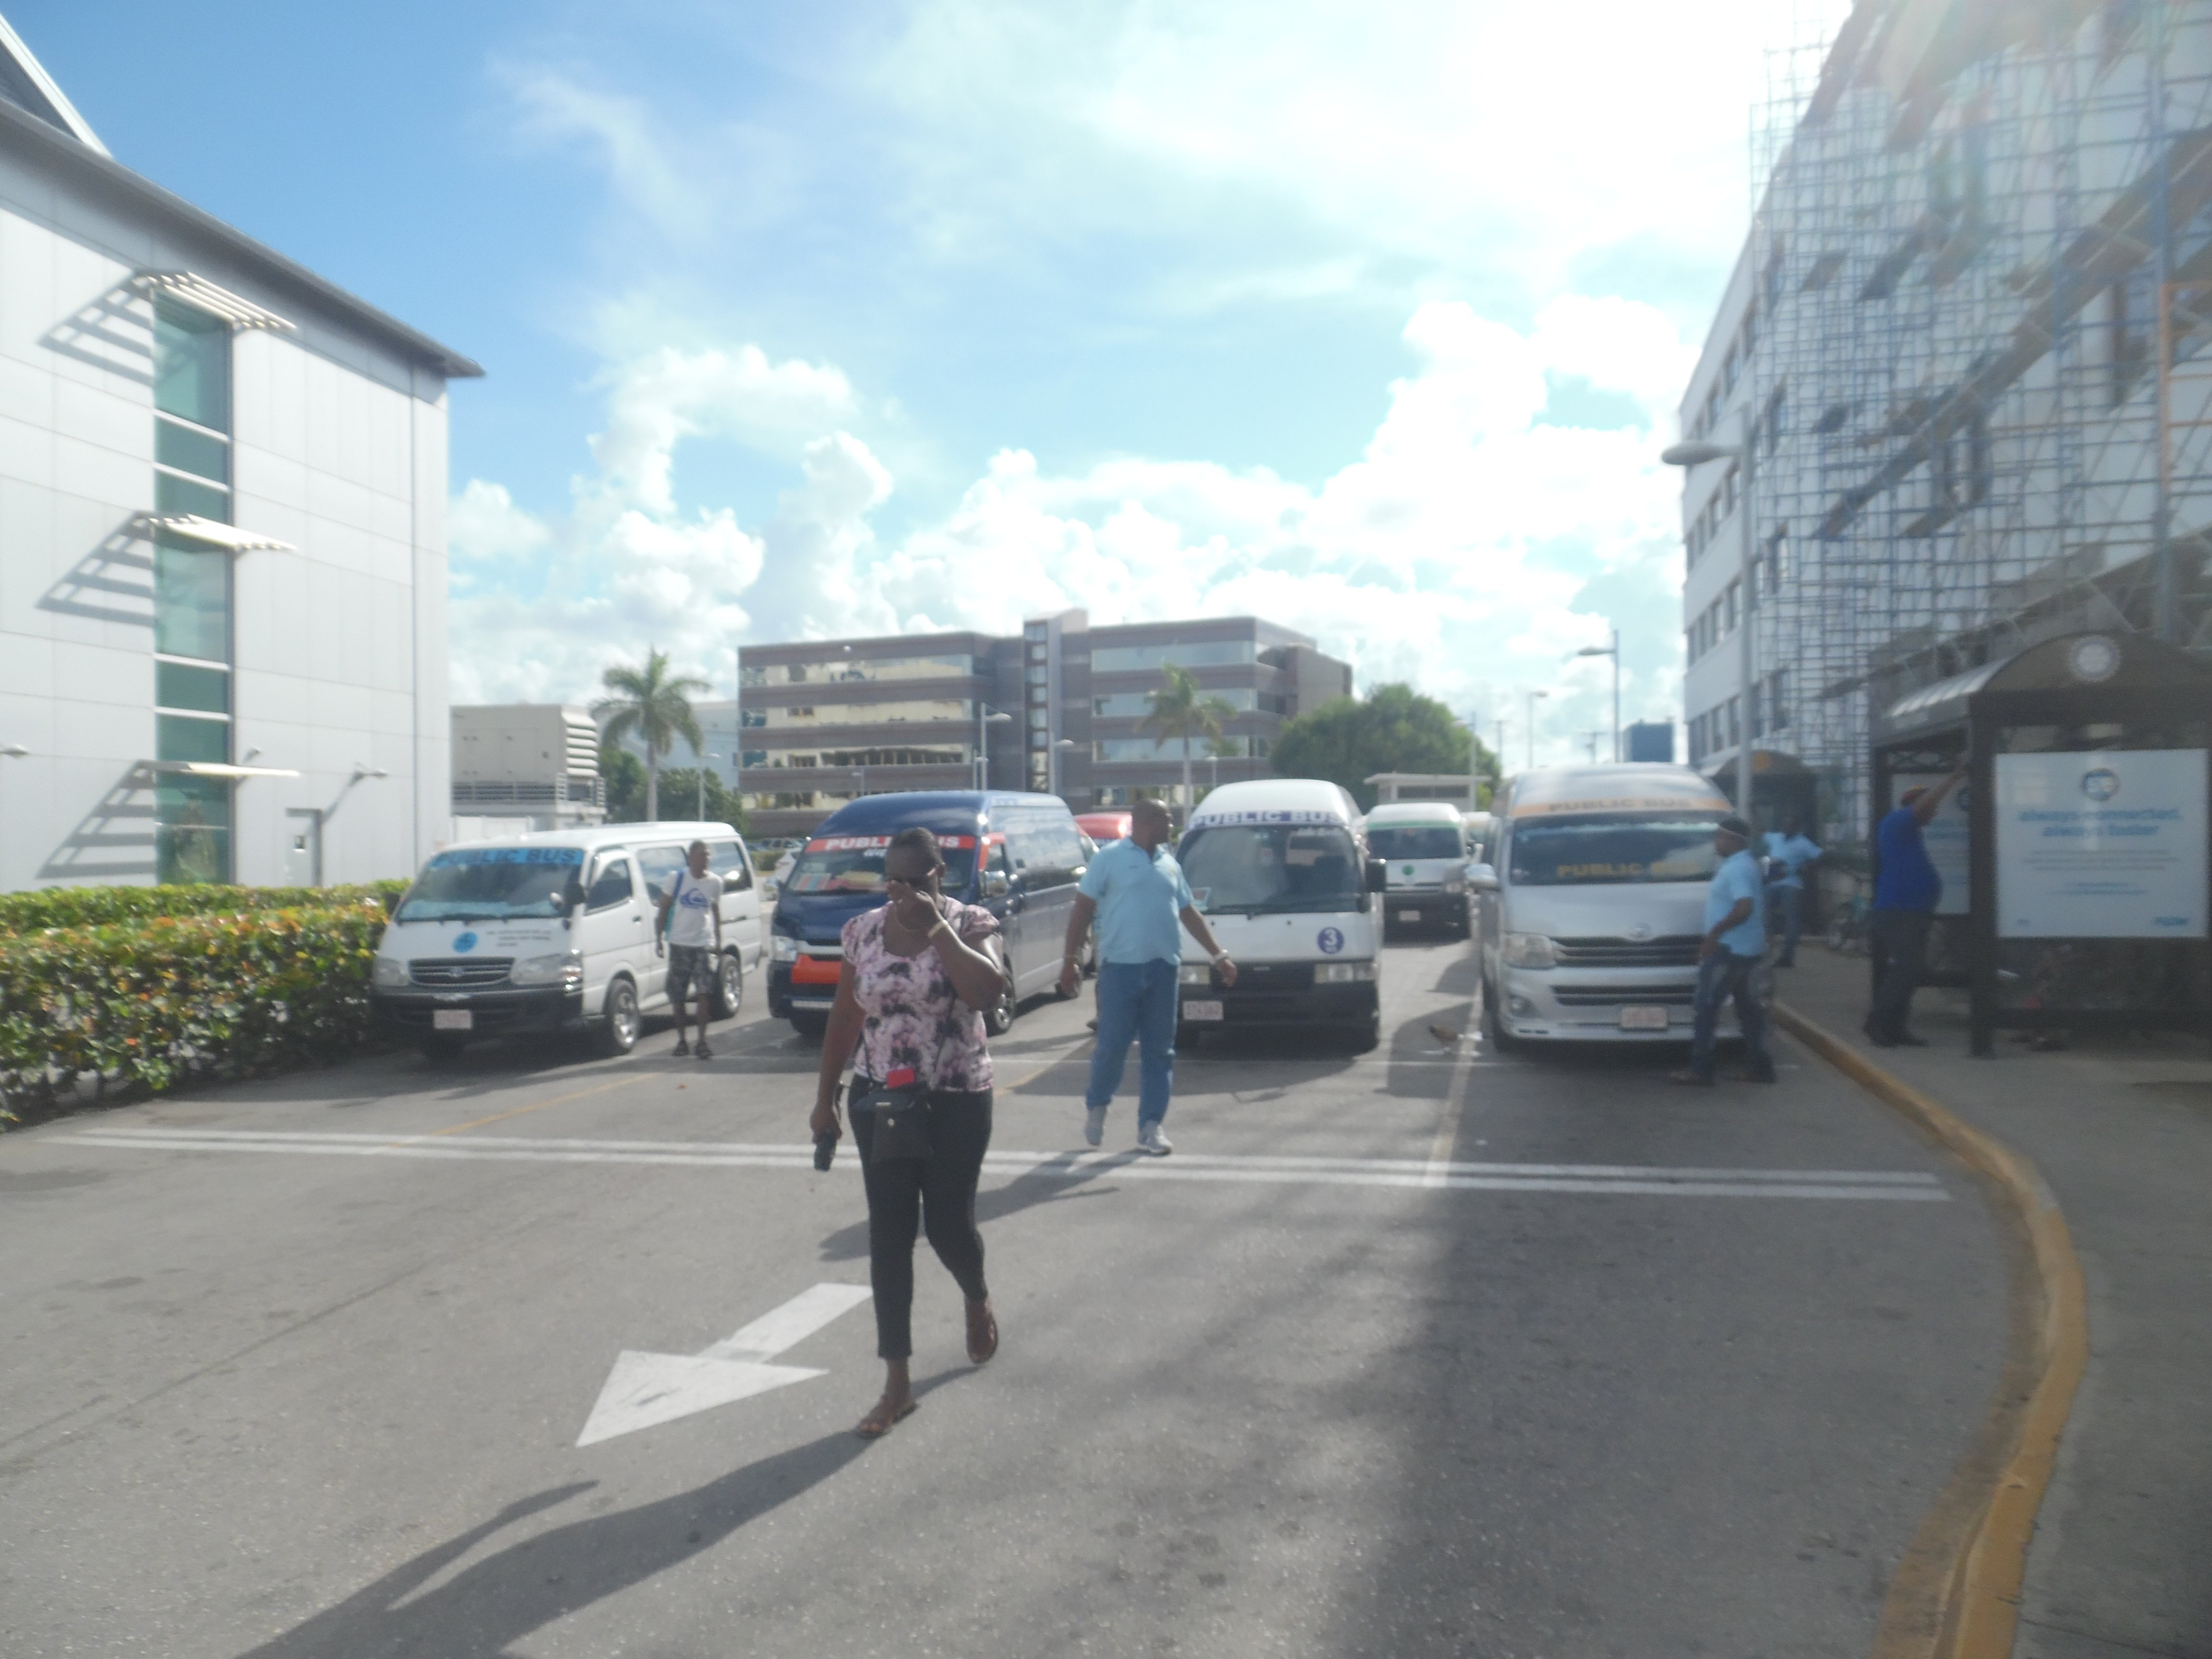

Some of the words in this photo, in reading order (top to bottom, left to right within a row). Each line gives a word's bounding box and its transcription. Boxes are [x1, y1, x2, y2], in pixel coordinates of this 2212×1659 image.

[1189, 811, 1279, 830] PUBLIC
[1291, 810, 1340, 824] BUS
[825, 835, 891, 851] PUBLI
[527, 849, 576, 864] BUS
[1325, 929, 1337, 946] 3
